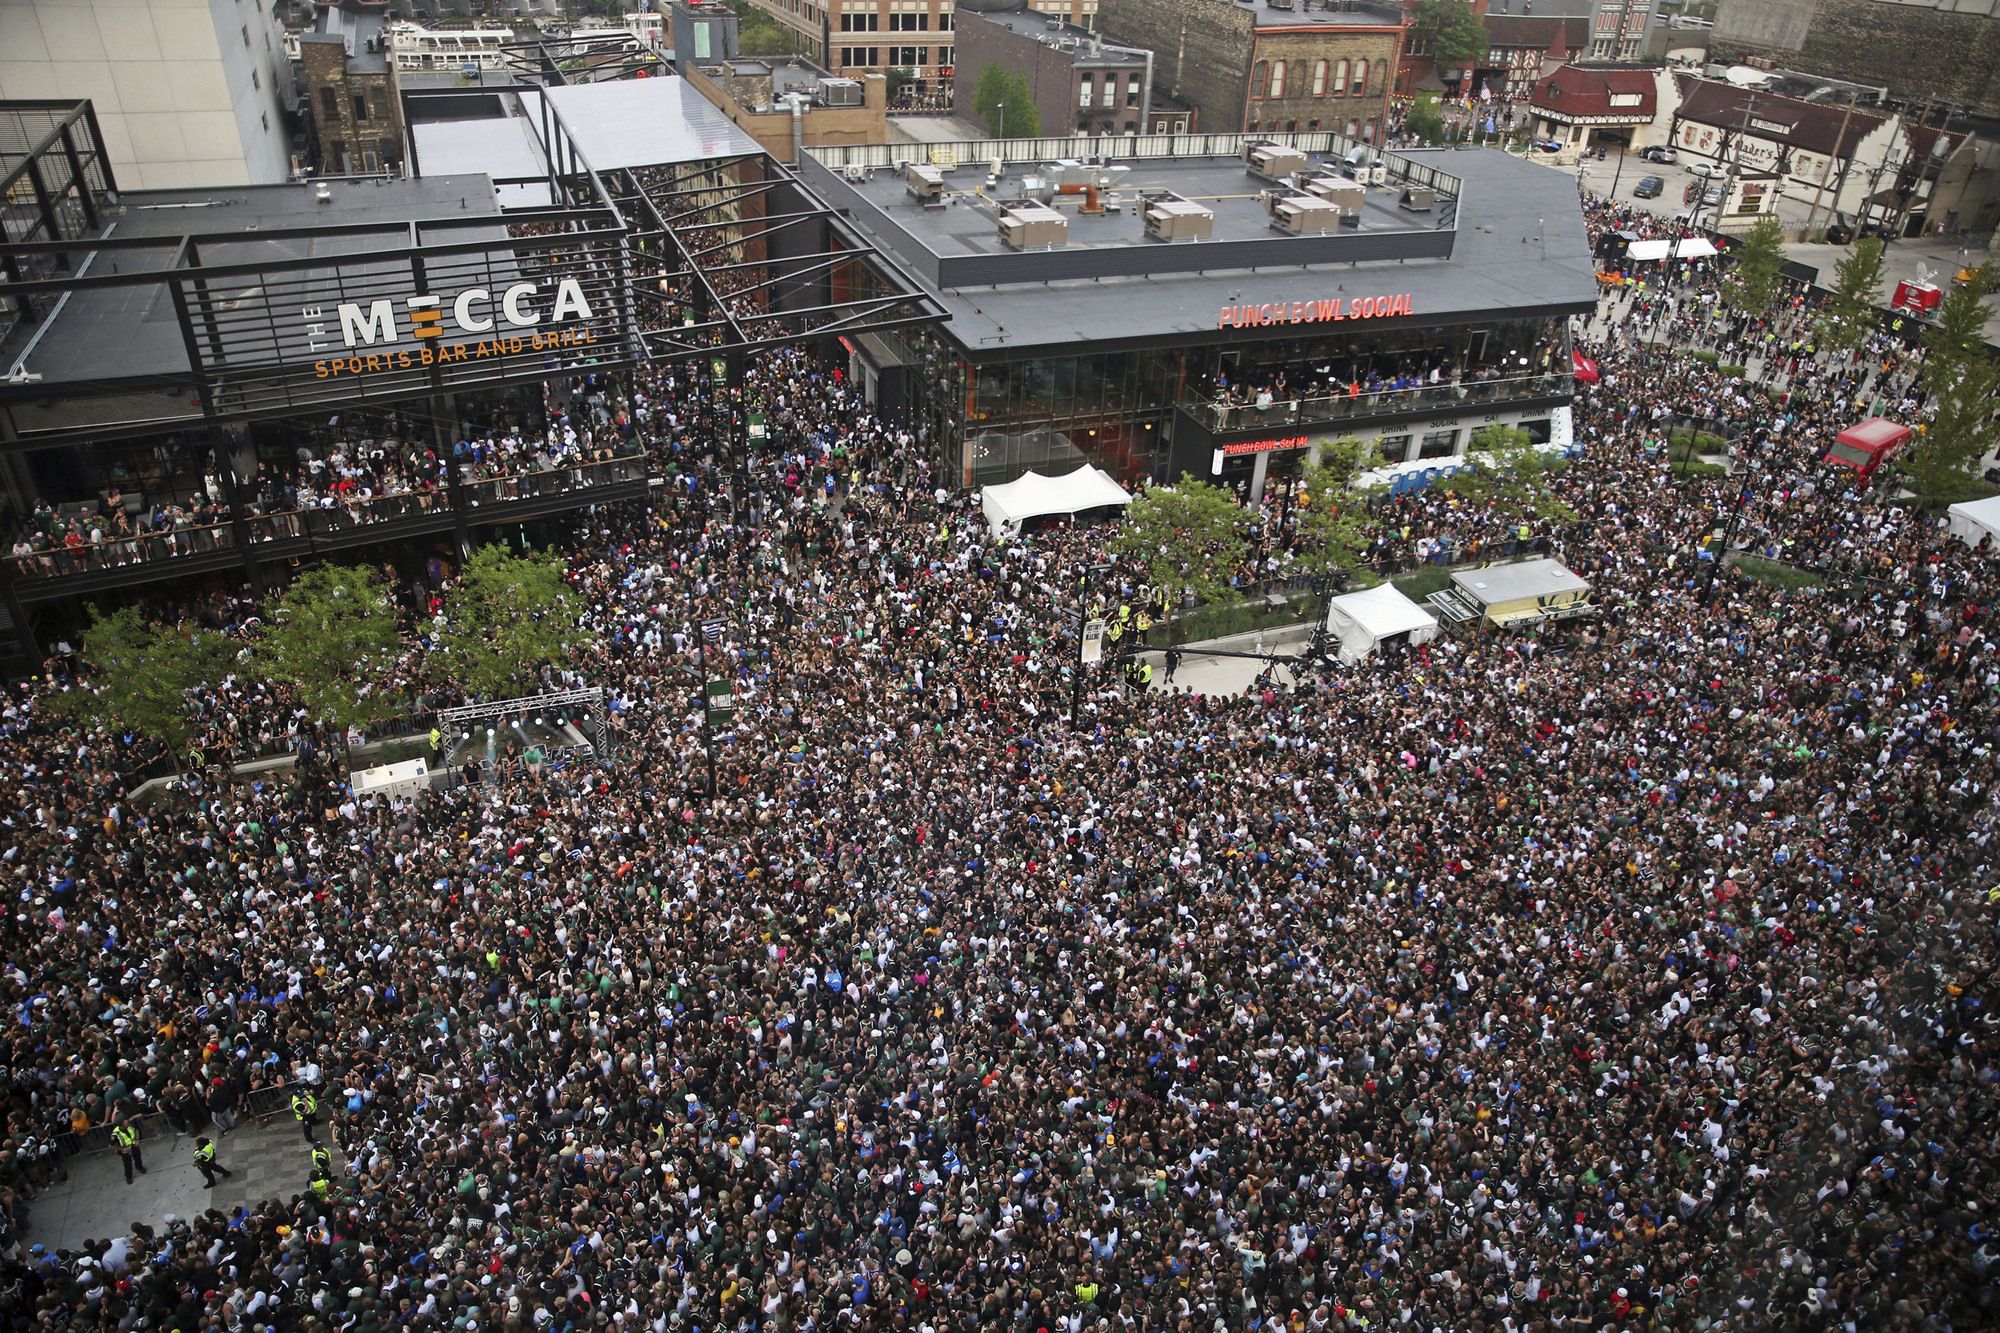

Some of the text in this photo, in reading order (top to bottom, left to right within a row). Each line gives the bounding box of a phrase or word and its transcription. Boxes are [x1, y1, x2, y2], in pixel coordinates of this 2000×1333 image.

[302, 305, 328, 352] THE
[337, 278, 594, 348] MECCA
[1219, 294, 1415, 330] PUNCH BOWL SOCIAL
[314, 328, 597, 378] SPORTS BAR AND GRILL
[1224, 443, 1254, 454] PUNCH
[1254, 440, 1278, 451] BOWL
